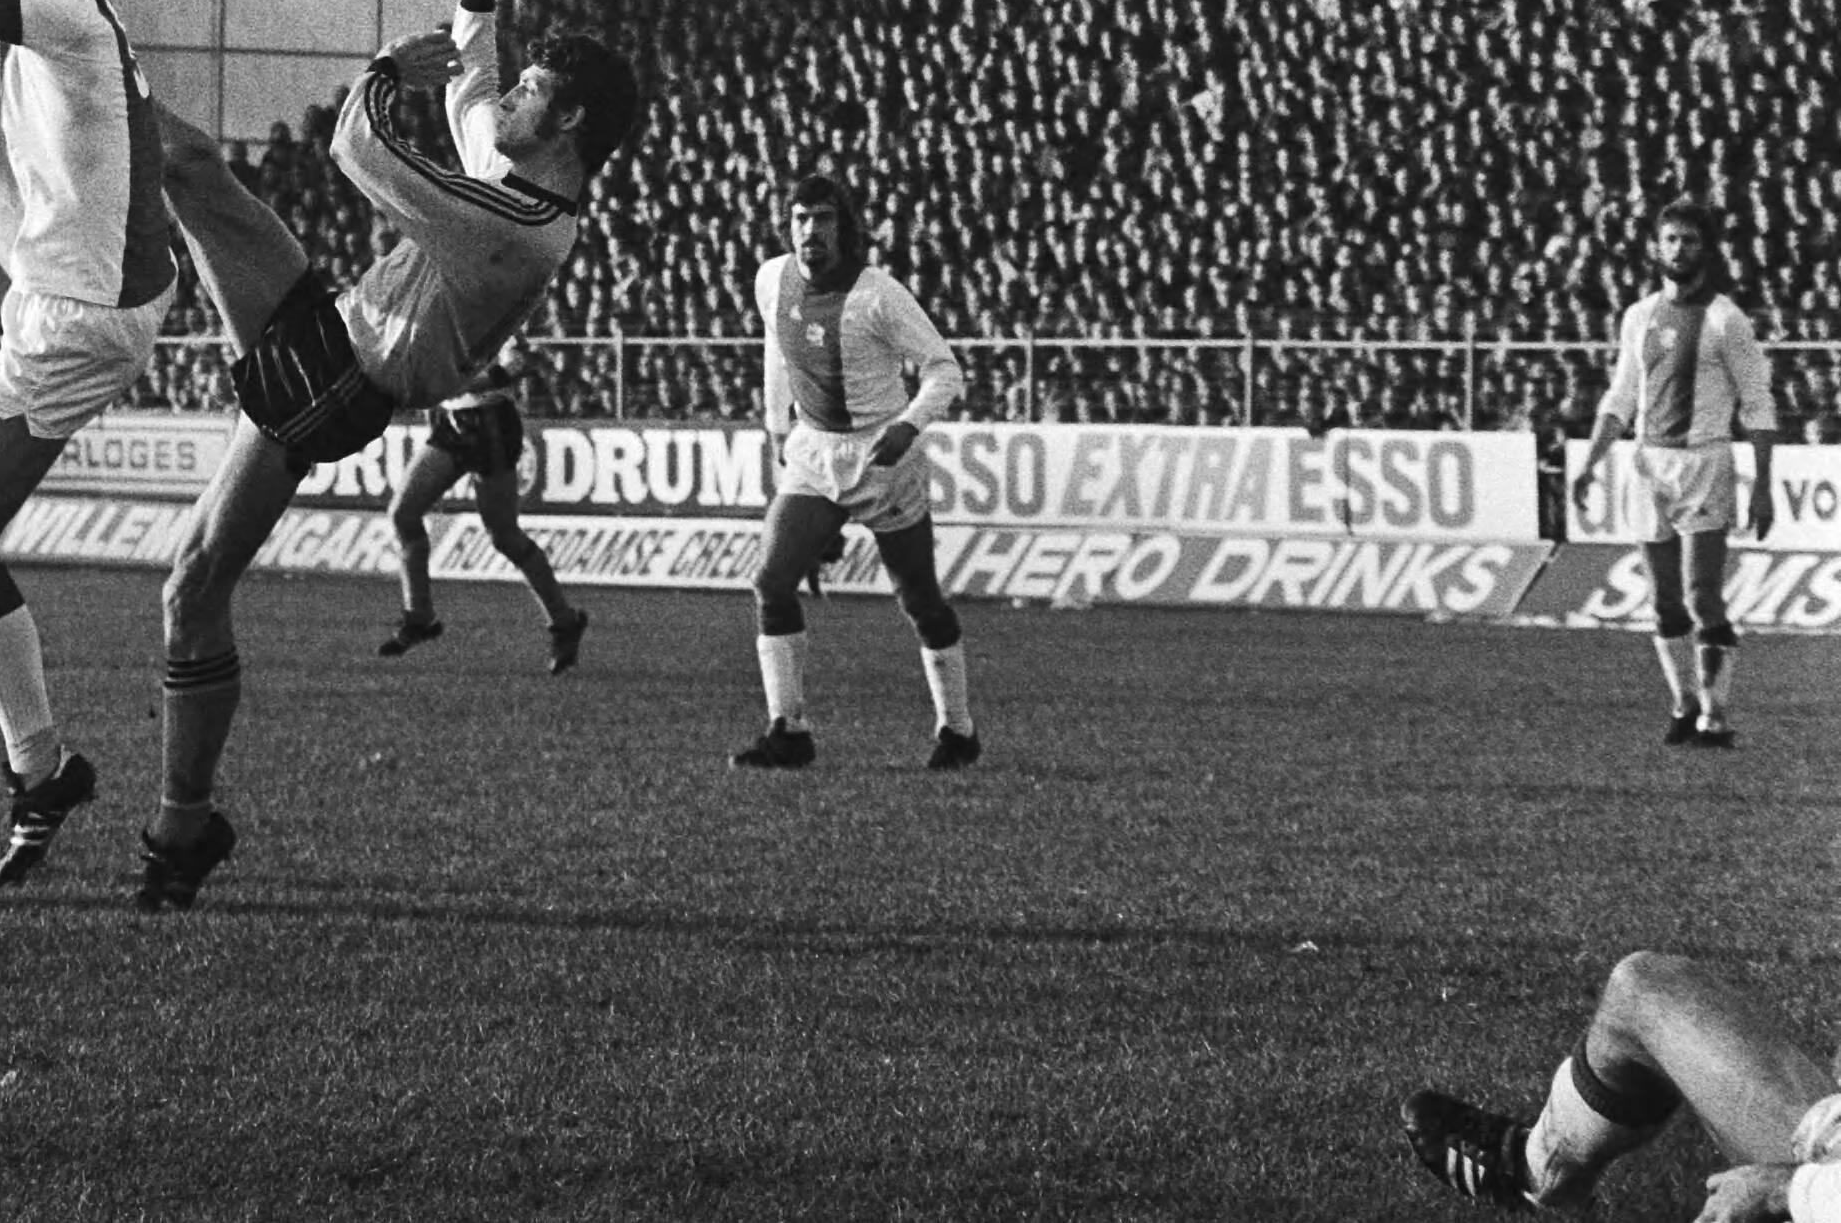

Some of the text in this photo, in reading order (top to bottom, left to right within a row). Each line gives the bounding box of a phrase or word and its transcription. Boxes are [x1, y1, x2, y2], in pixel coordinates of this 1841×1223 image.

[61, 439, 197, 470] RLOGES
[541, 429, 768, 506] DRUM
[922, 432, 1046, 518] SSO
[1057, 433, 1272, 522] EXTRA
[1287, 437, 1475, 529] ESSO
[950, 532, 1514, 613] HERO DRINKS
